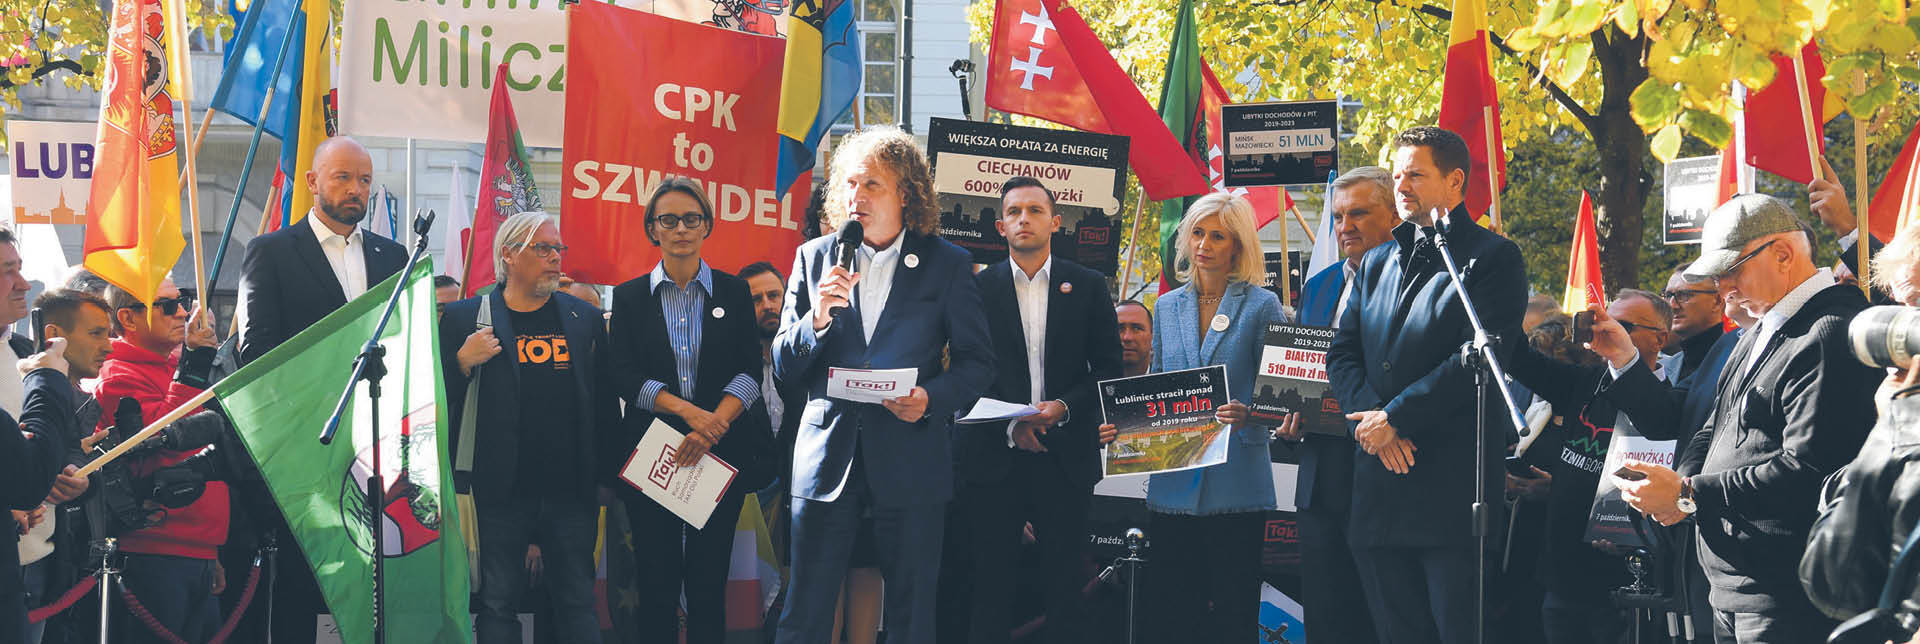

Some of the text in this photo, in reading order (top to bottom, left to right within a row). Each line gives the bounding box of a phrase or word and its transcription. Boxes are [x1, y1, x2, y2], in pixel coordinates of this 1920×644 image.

[373, 17, 564, 92] Milicz
[653, 82, 741, 132] CPK
[948, 132, 1109, 160] WIĘKSZA OPŁATA ZA ENERGIĘ
[1279, 135, 1291, 148] 51
[1296, 134, 1324, 147] MLN
[15, 141, 95, 179] LUB
[673, 132, 714, 172] to
[977, 159, 1072, 181] CIECHANÓW
[964, 179, 1003, 195] 600%
[1268, 324, 1294, 334] UBYTKI
[1293, 338, 1331, 348] 2019-2023
[1285, 350, 1327, 364] BIAŁYSTO
[1267, 362, 1286, 375] 519
[1287, 366, 1306, 378] mln
[1115, 385, 1213, 405] Lubliniec stracił ponad
[1145, 395, 1212, 417] 31 mln
[1162, 418, 1179, 426] 2019
[1090, 534, 1096, 542] 7
